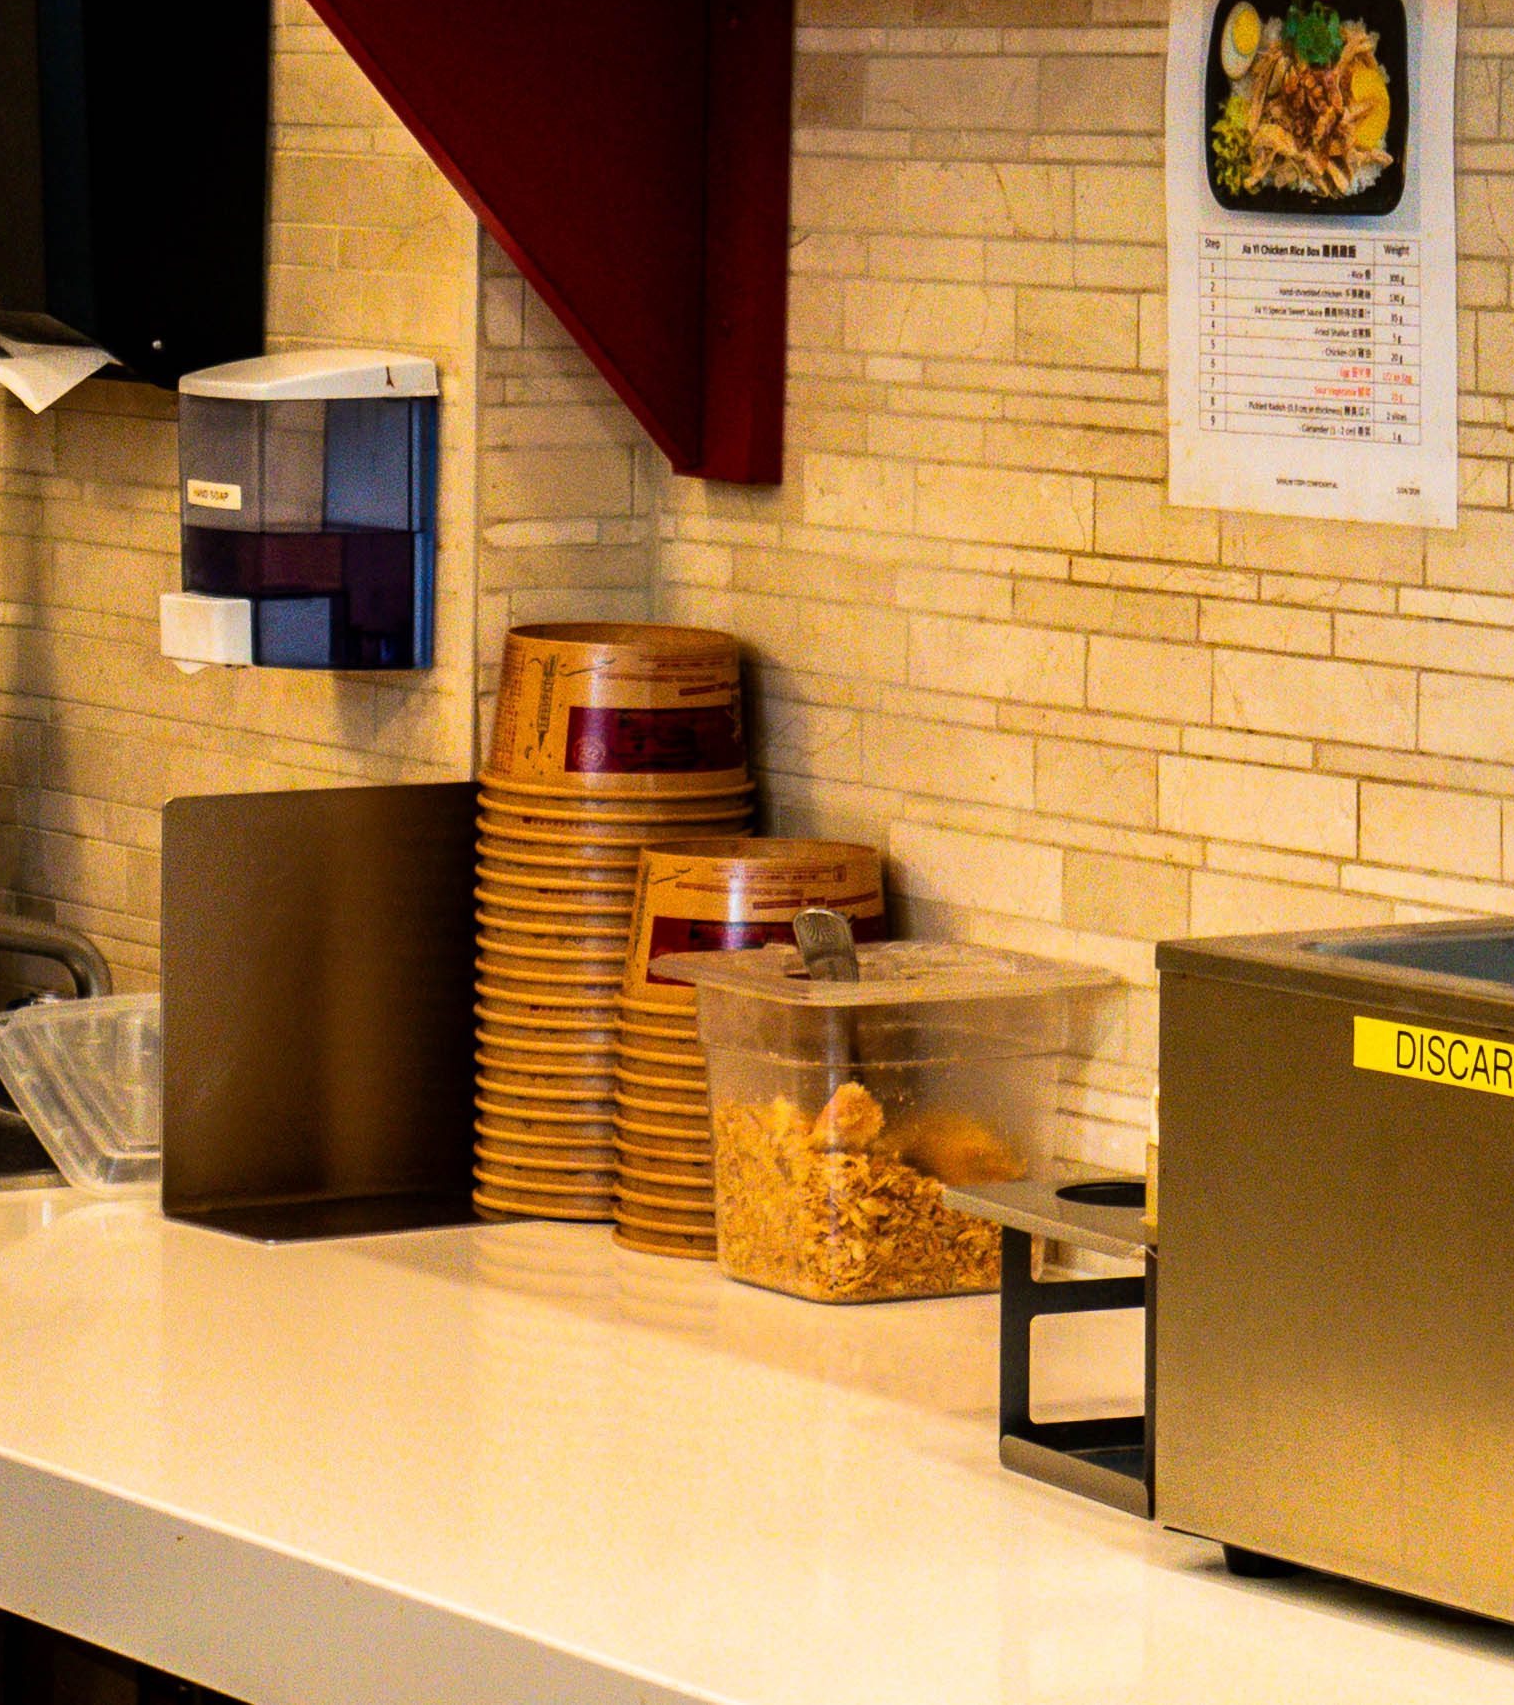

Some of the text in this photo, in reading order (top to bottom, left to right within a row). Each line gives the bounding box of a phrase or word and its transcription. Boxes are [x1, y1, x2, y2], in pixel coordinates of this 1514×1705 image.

[1205, 238, 1221, 250] Step
[1383, 243, 1410, 257] Weight
[1261, 245, 1288, 255] Chicken
[1290, 245, 1305, 256] Rice
[1307, 246, 1320, 256] Box
